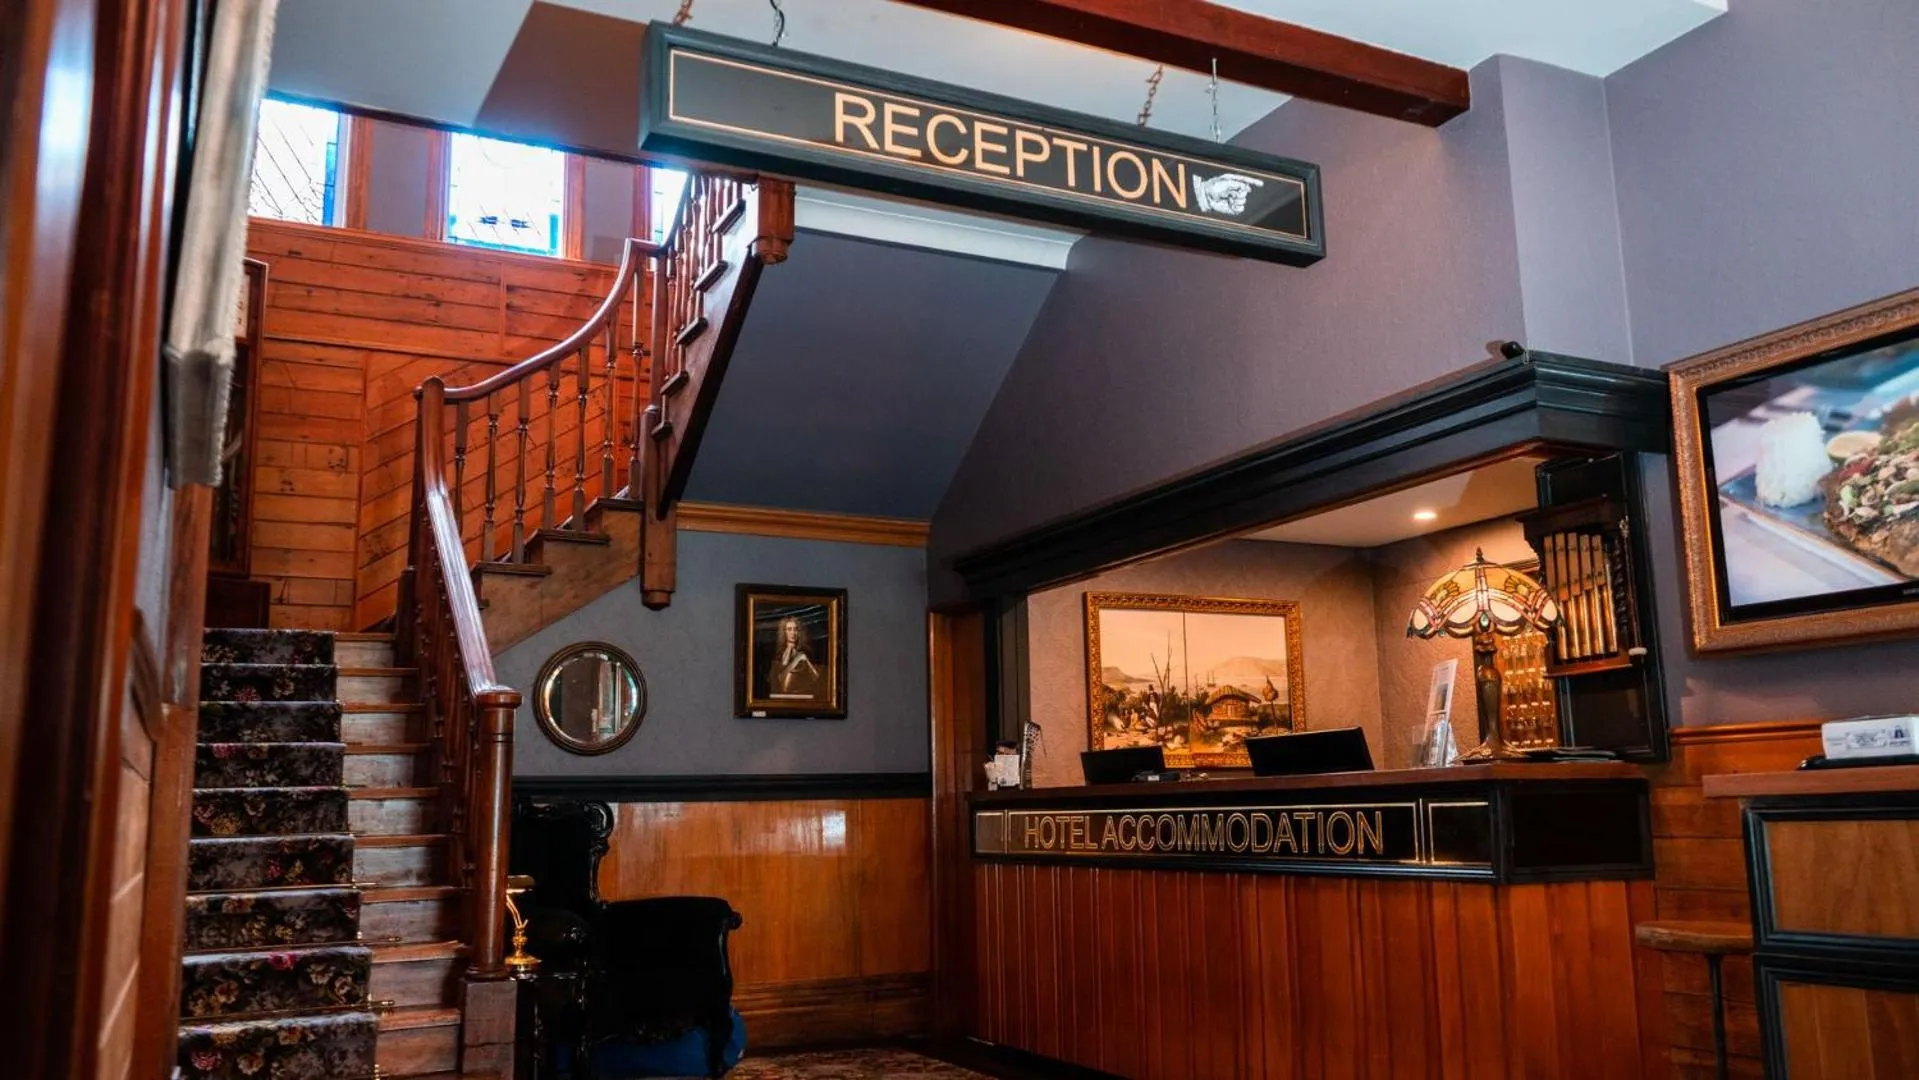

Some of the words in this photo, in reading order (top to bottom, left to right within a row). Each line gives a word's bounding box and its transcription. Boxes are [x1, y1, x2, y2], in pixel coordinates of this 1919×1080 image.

[834, 92, 1187, 209] RECEPTION
[1024, 815, 1098, 849] HOTEL
[1101, 811, 1384, 855] ACCOMMODATION
